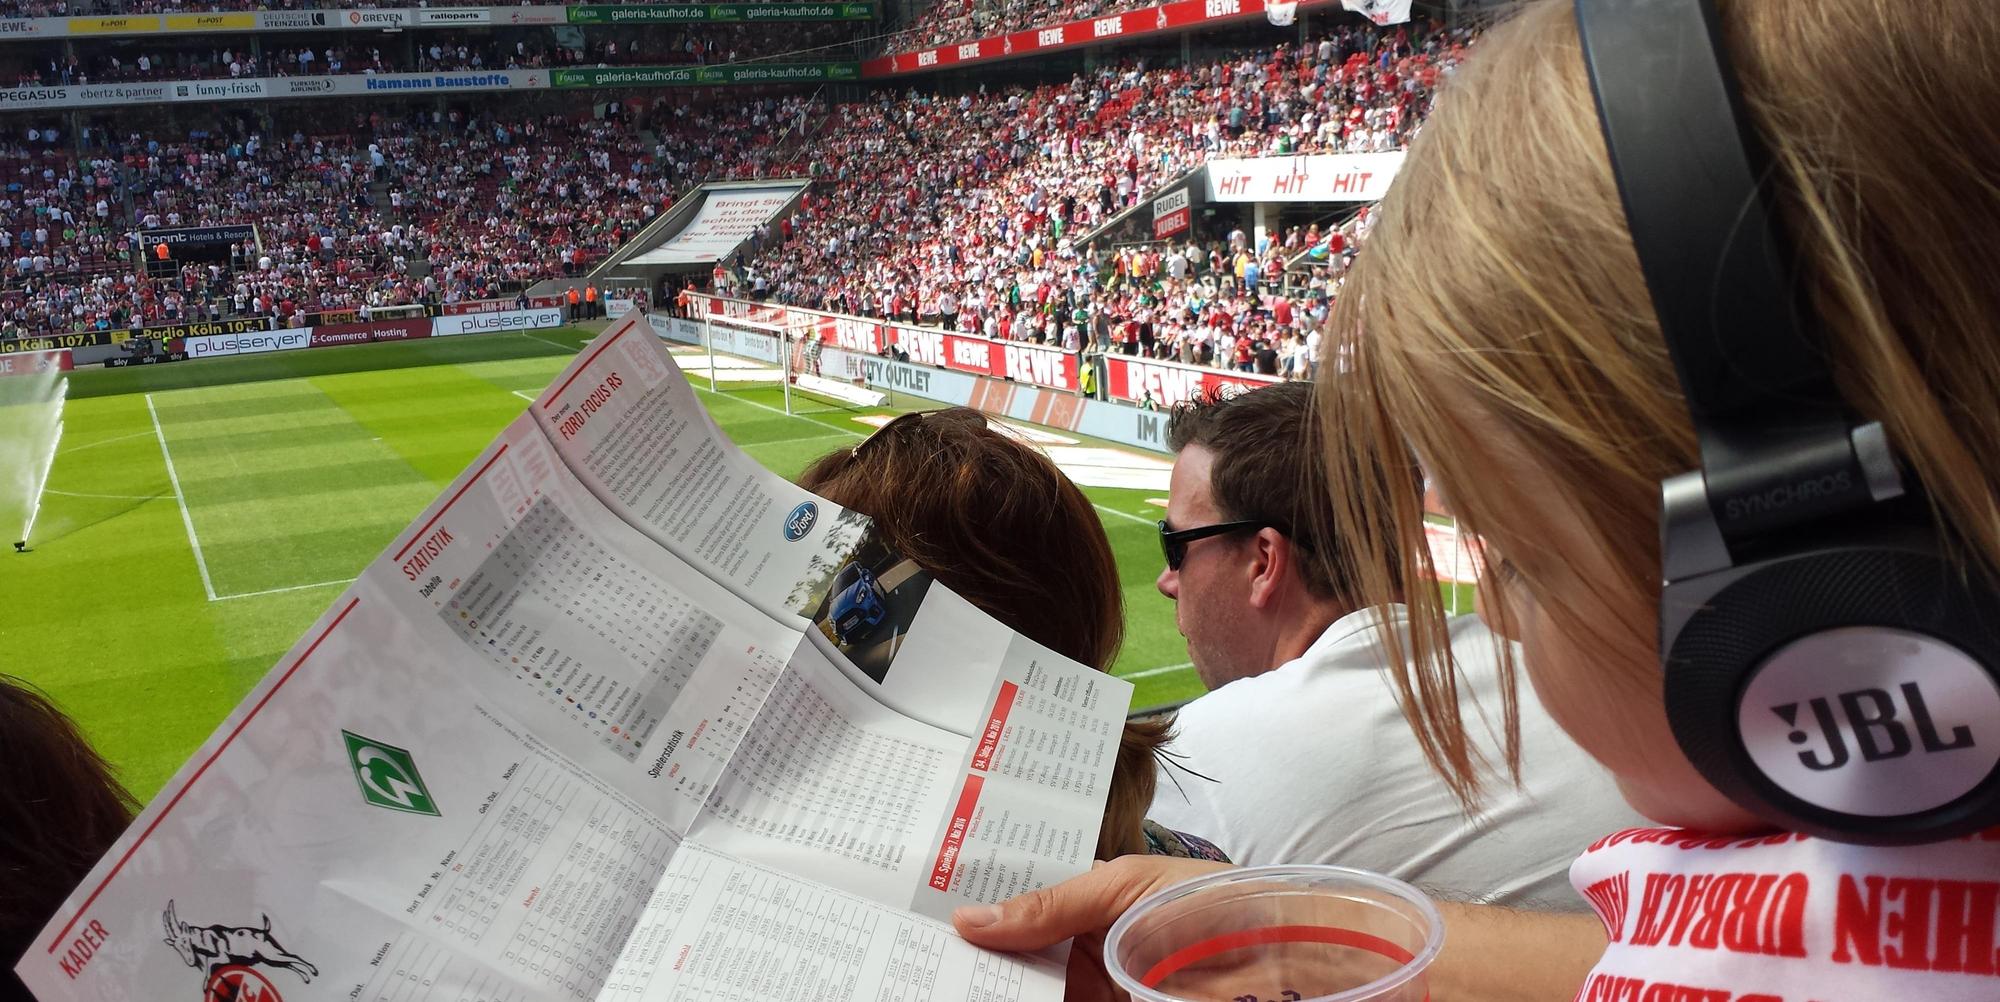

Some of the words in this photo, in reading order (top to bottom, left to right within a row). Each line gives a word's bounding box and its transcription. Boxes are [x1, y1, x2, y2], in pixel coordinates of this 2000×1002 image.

[362, 13, 403, 22] GREVEN
[612, 8, 704, 21] galeria-kaufhof.de
[747, 7, 833, 18] galeria-kaufhof.de
[1205, 0, 1241, 17] REWE
[264, 20, 309, 28] STEINZEUG
[1094, 16, 1123, 37] REWE
[1038, 27, 1064, 47] REWE
[918, 50, 938, 67] REWE
[958, 42, 980, 60] REWE
[366, 76, 433, 90] Hamann
[435, 73, 509, 87] Baustoffe
[595, 71, 690, 84] galeria-kaufhof.de
[734, 68, 822, 80] galeria-kaufhof.de
[0, 89, 67, 101] PEGASUS
[81, 88, 113, 98] ebertz
[116, 88, 123, 97] &
[125, 87, 163, 99] partner
[196, 82, 261, 96] funny-frisch
[1219, 176, 1252, 195] HIT
[1273, 174, 1305, 195] HIT
[1333, 173, 1373, 194] HIT
[1156, 195, 1185, 215] RUDEL
[1156, 215, 1186, 237] JUBEL
[143, 233, 187, 245] Dorint
[190, 233, 214, 241] Hotels
[216, 232, 222, 240] &
[189, 323, 222, 336] Köln
[312, 331, 367, 343] E-Commerce
[374, 327, 407, 338] Hosting
[836, 319, 876, 353] REWE
[20, 339, 54, 351] Köln
[898, 328, 946, 366] REWE
[954, 340, 989, 368] REWE
[113, 358, 128, 366] sky
[143, 355, 157, 364] sky
[170, 352, 182, 360] sky
[859, 358, 883, 382] CITY
[886, 362, 931, 393] OUTLET
[1005, 348, 1067, 388] REWE
[1127, 362, 1203, 407] REWE
[560, 411, 586, 441] FORD
[580, 384, 611, 418] FOCUS
[606, 372, 623, 391] RS
[1137, 414, 1158, 443] IM
[1725, 470, 1853, 519] SYNCHROS
[789, 509, 814, 536] Ford
[402, 526, 453, 581] STATISTIK
[419, 575, 443, 599] Tabelle
[1799, 681, 1976, 771] JBL
[646, 727, 686, 779] Spielerstatistik
[440, 849, 457, 867] Name
[502, 760, 520, 780] Nation
[937, 844, 959, 874] Spieltag:
[934, 873, 948, 887] 33.
[1629, 872, 1809, 958] URBACH
[58, 919, 110, 979] KADER
[370, 941, 391, 966] Nation
